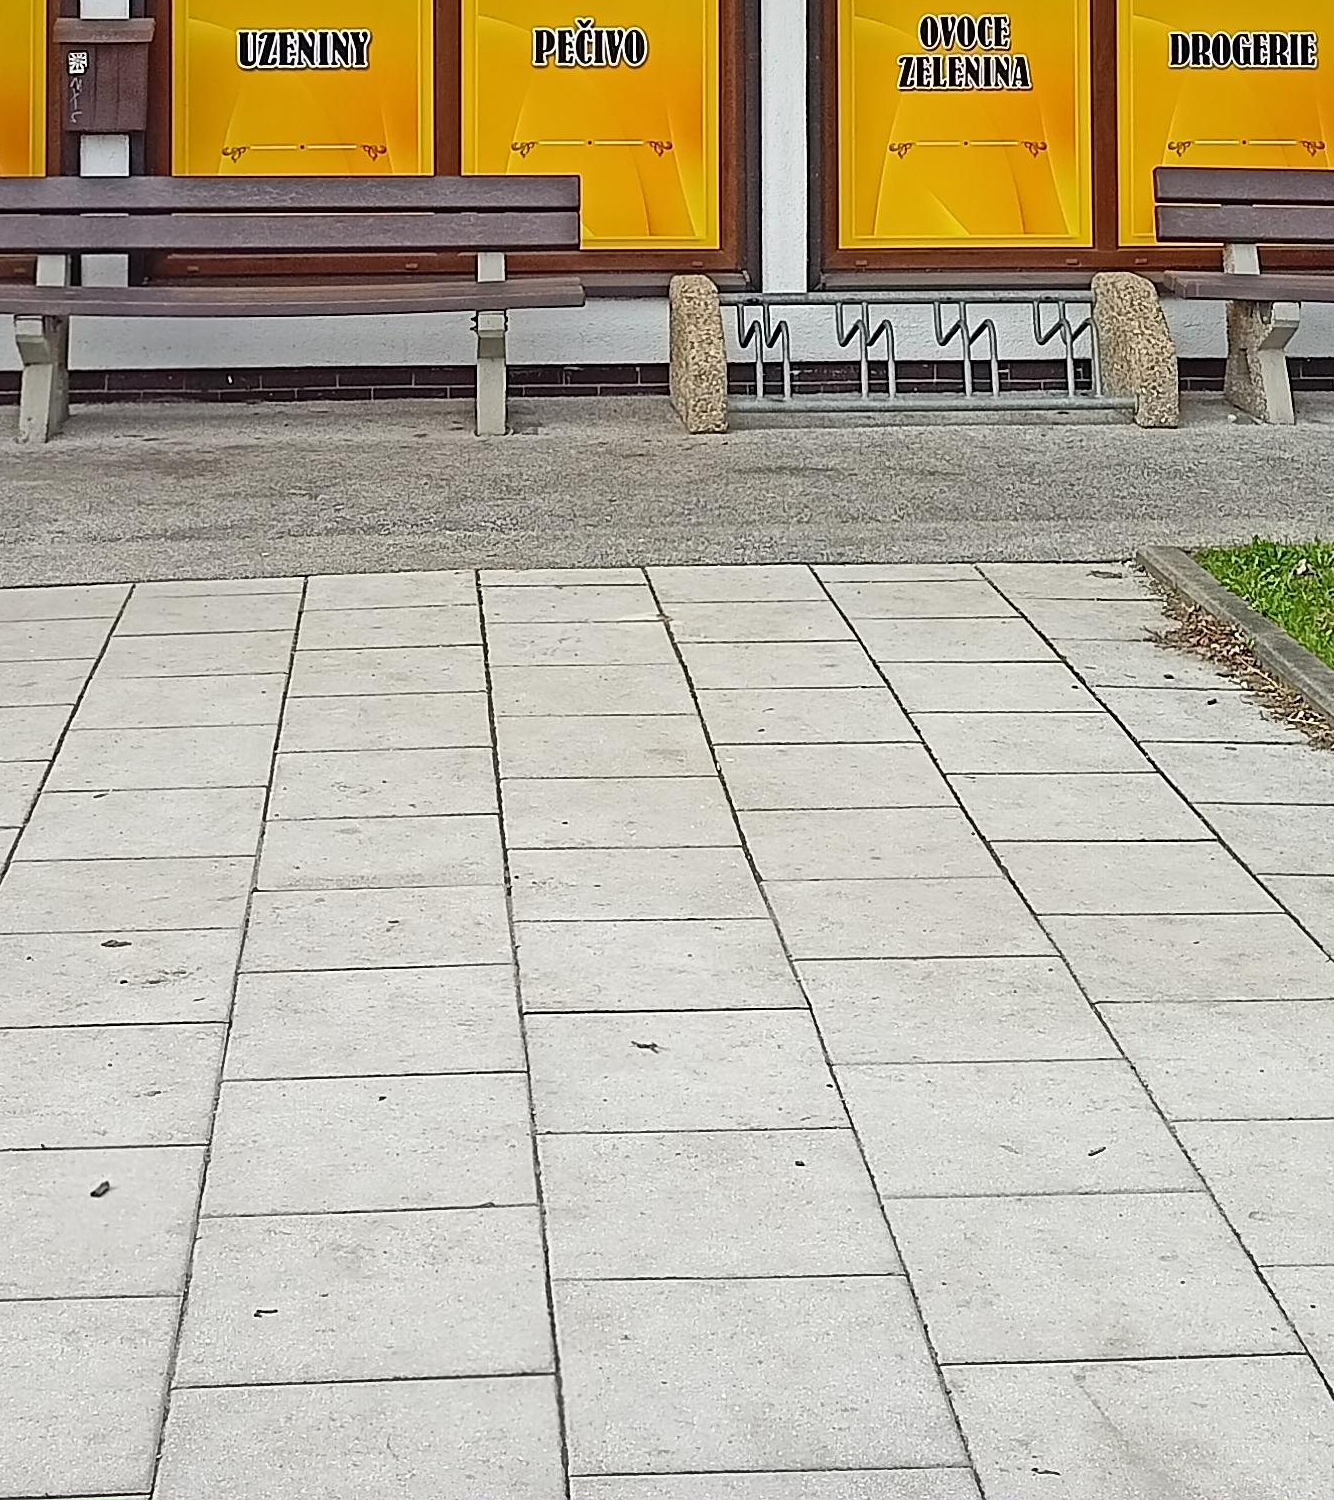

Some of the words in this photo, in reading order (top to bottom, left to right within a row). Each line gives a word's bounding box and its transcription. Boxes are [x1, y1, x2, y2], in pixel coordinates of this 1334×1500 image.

[236, 30, 371, 68] UZENINY
[532, 17, 648, 67] PEČIVO
[918, 14, 1011, 50] OVOCE
[1168, 32, 1318, 68] DROGERIE
[897, 54, 1033, 90] ZELENINA
